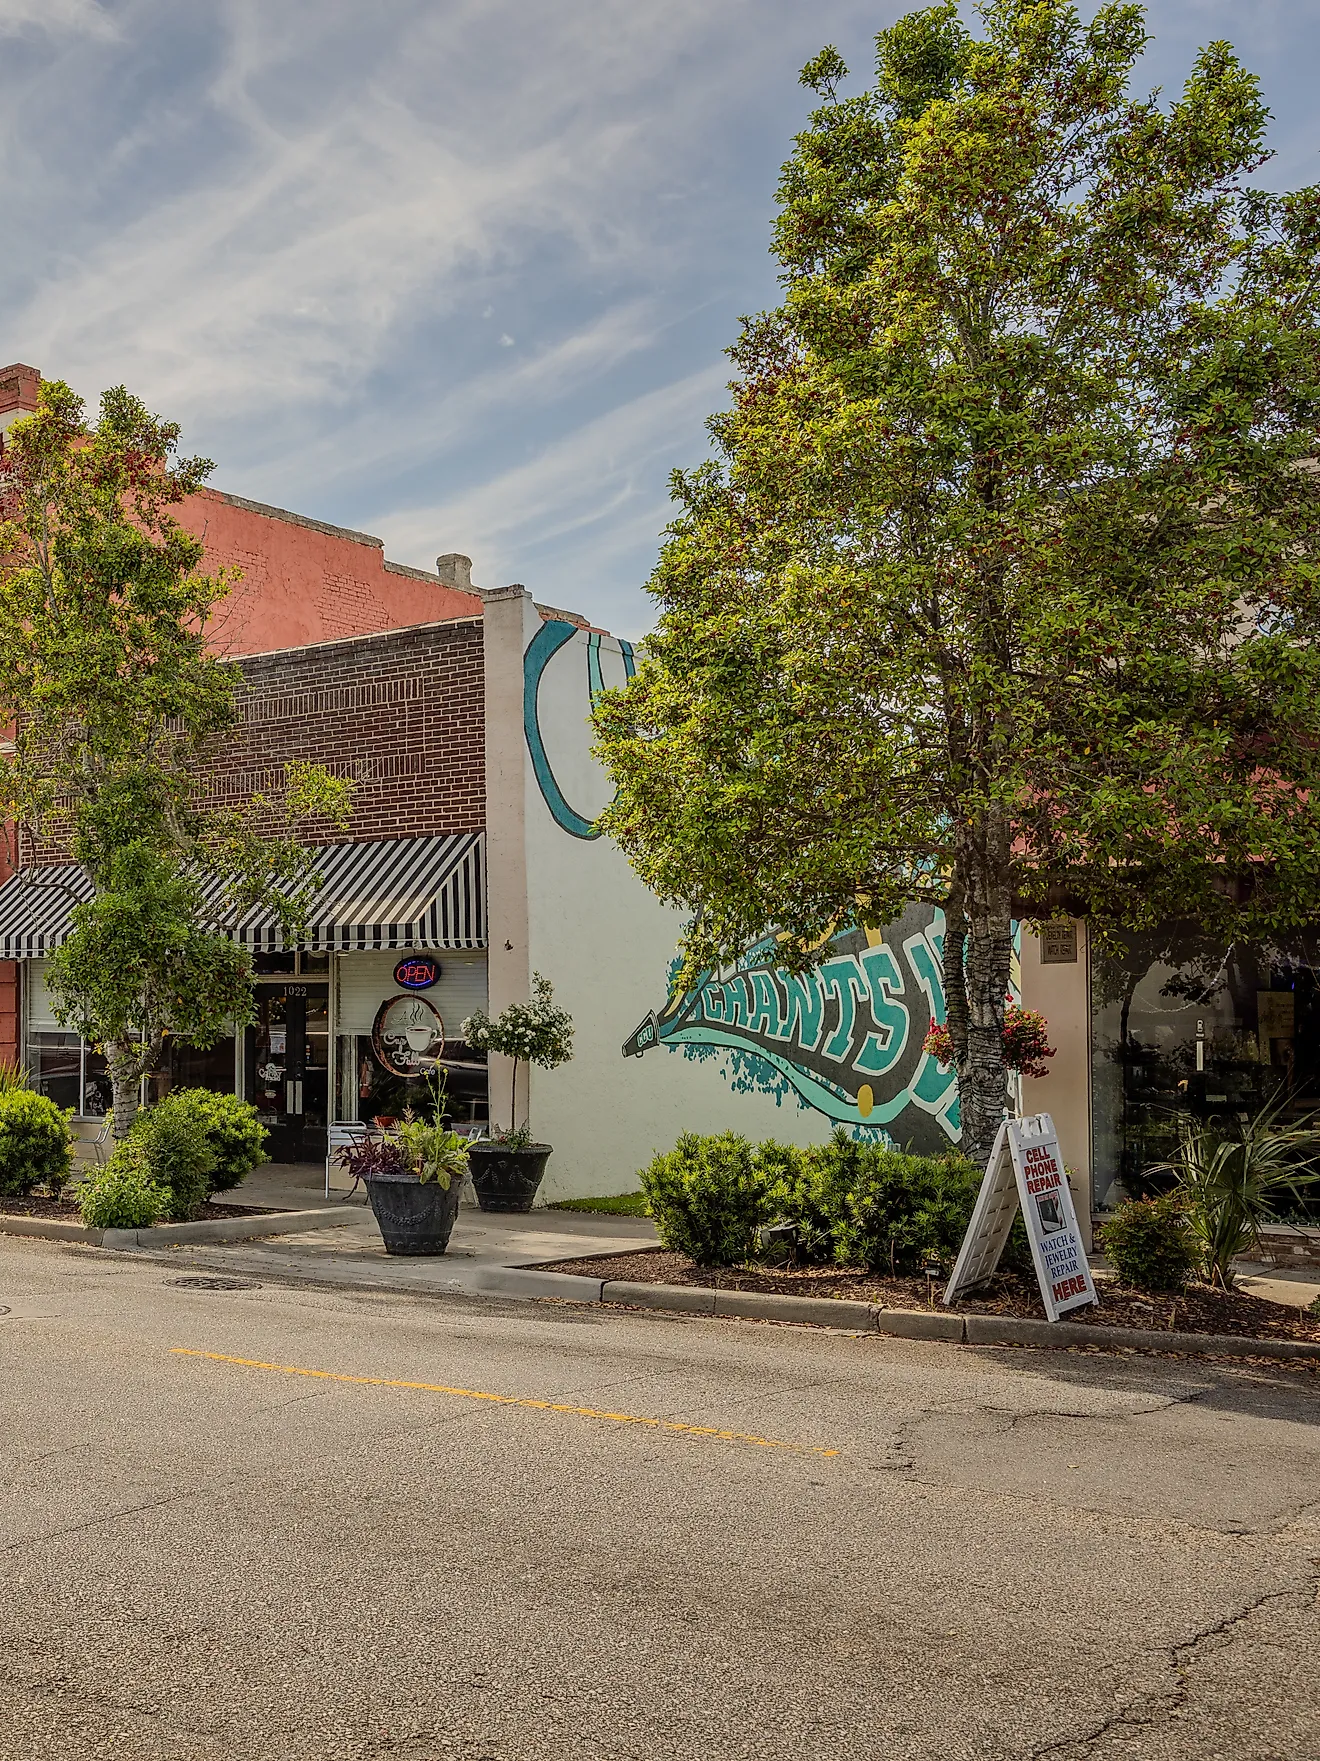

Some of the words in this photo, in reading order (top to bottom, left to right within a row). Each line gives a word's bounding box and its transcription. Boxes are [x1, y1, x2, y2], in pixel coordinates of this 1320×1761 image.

[396, 965, 436, 982] OPEN
[283, 986, 307, 997] 1022
[700, 943, 910, 1076] CHANTS
[383, 1030, 408, 1052] Cup
[1025, 1146, 1051, 1164] CELL
[1024, 1158, 1058, 1180] PHONE
[1026, 1173, 1062, 1195] REPAIR
[1040, 1235, 1069, 1253] WATCH
[1069, 1232, 1076, 1244] &
[1045, 1246, 1078, 1270] JEWELRY
[1051, 1260, 1079, 1279] REPAIR
[1052, 1274, 1088, 1302] HERE
